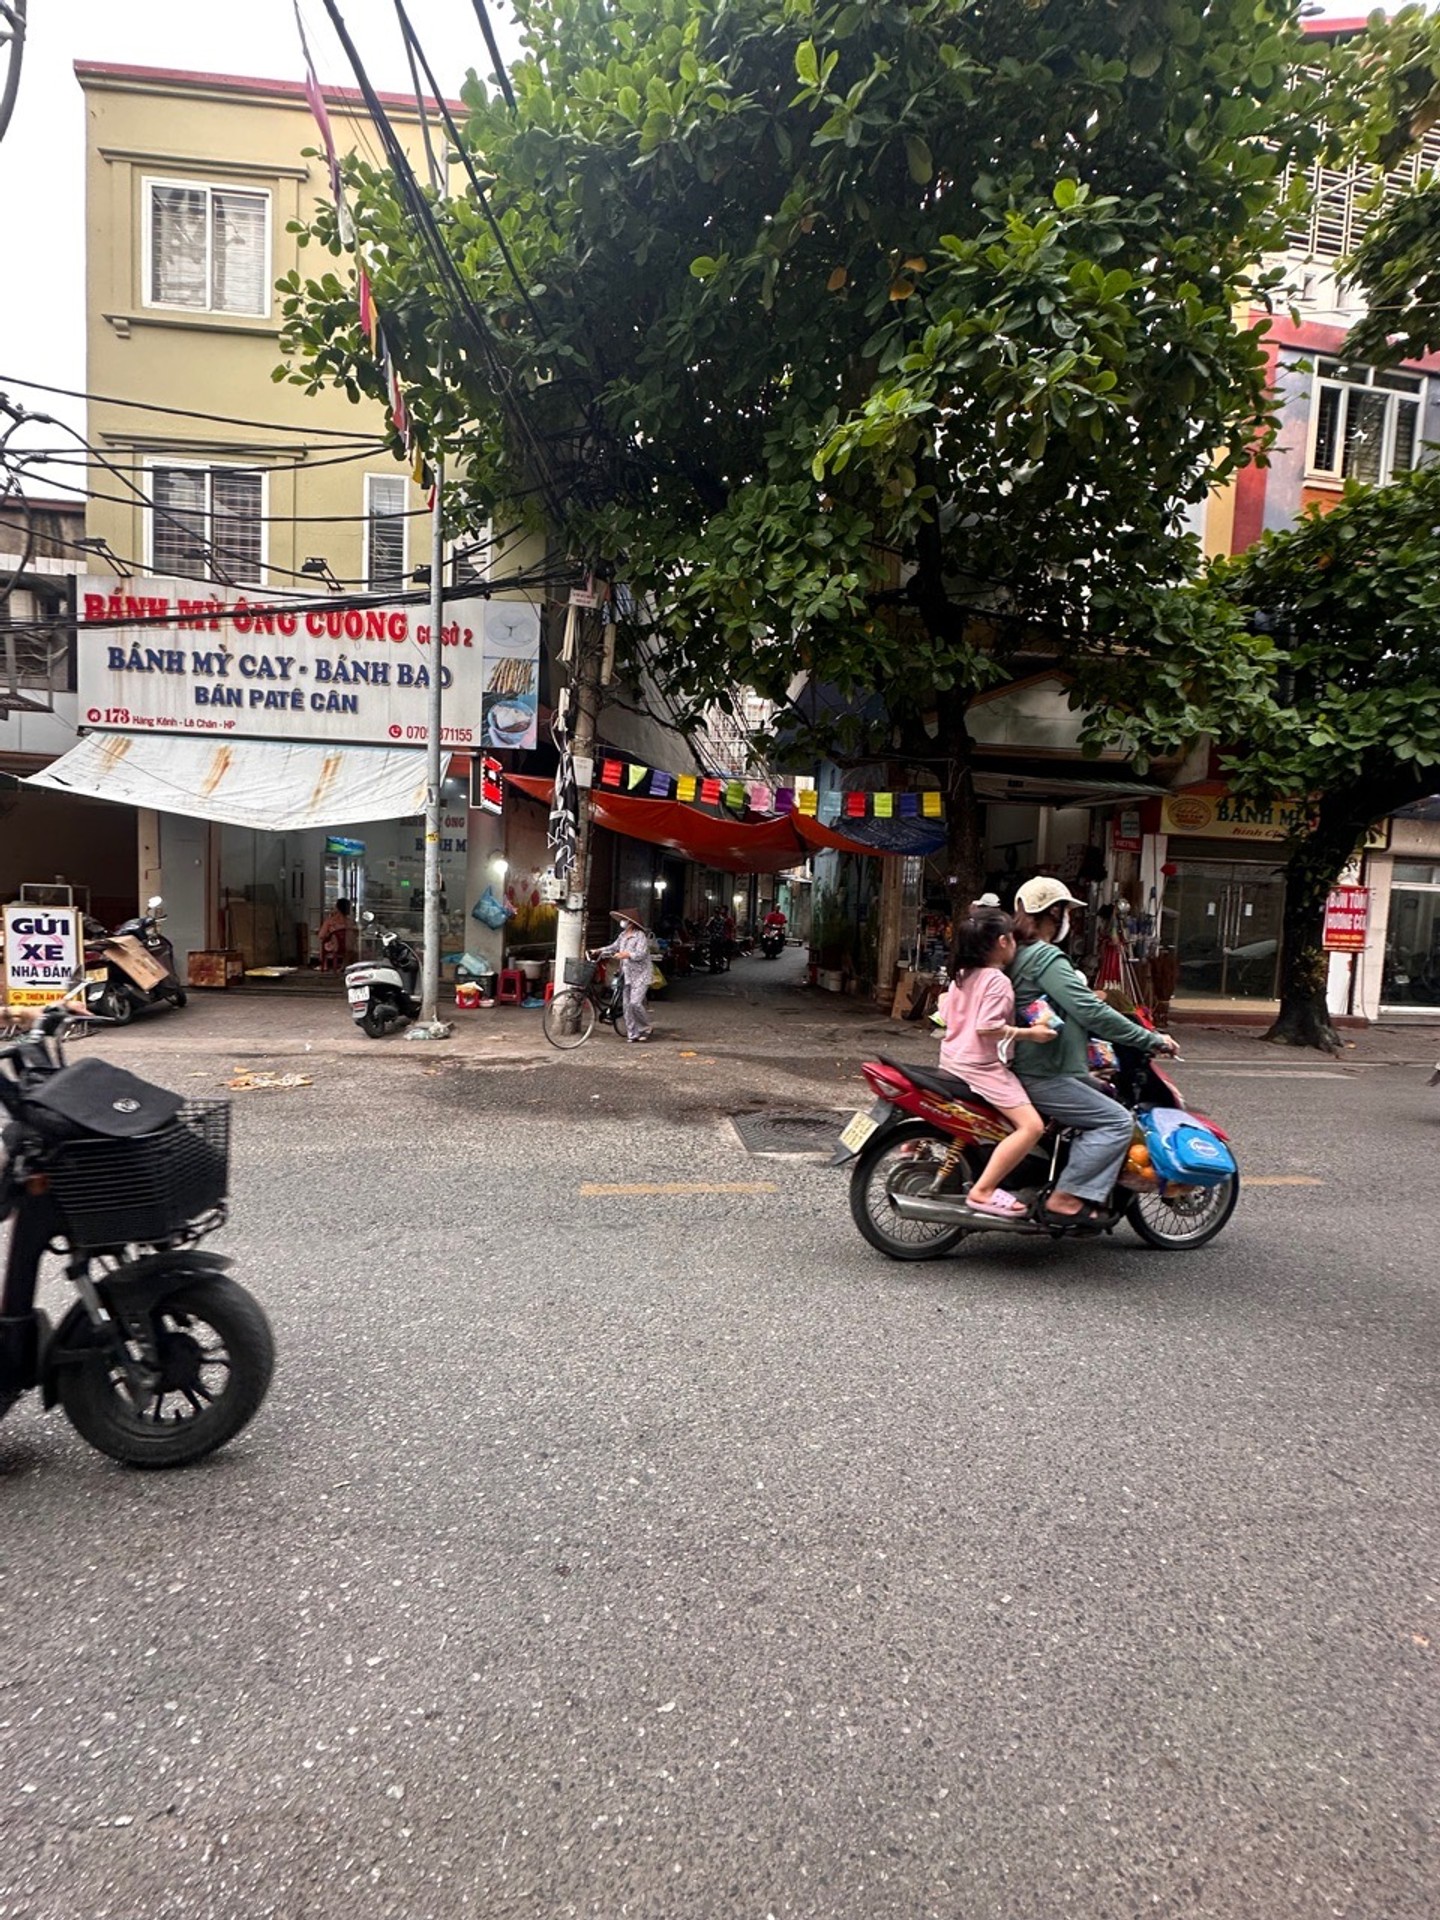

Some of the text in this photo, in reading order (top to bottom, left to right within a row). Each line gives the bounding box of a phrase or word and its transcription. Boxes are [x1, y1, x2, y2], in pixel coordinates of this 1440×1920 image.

[84, 587, 169, 628] BÁNH
[232, 596, 297, 637] ÔNG
[463, 628, 473, 647] 2
[107, 641, 186, 675] BÁNH
[192, 643, 234, 678] MỲ
[239, 652, 296, 680] CAY
[315, 654, 391, 686] BÁNH
[250, 688, 305, 711] PATÊ
[310, 690, 359, 714] CÂN
[103, 707, 130, 724] 173
[197, 718, 217, 729] Chân
[224, 720, 236, 729] HP
[11, 912, 70, 936] GỬI
[20, 943, 64, 961] XE
